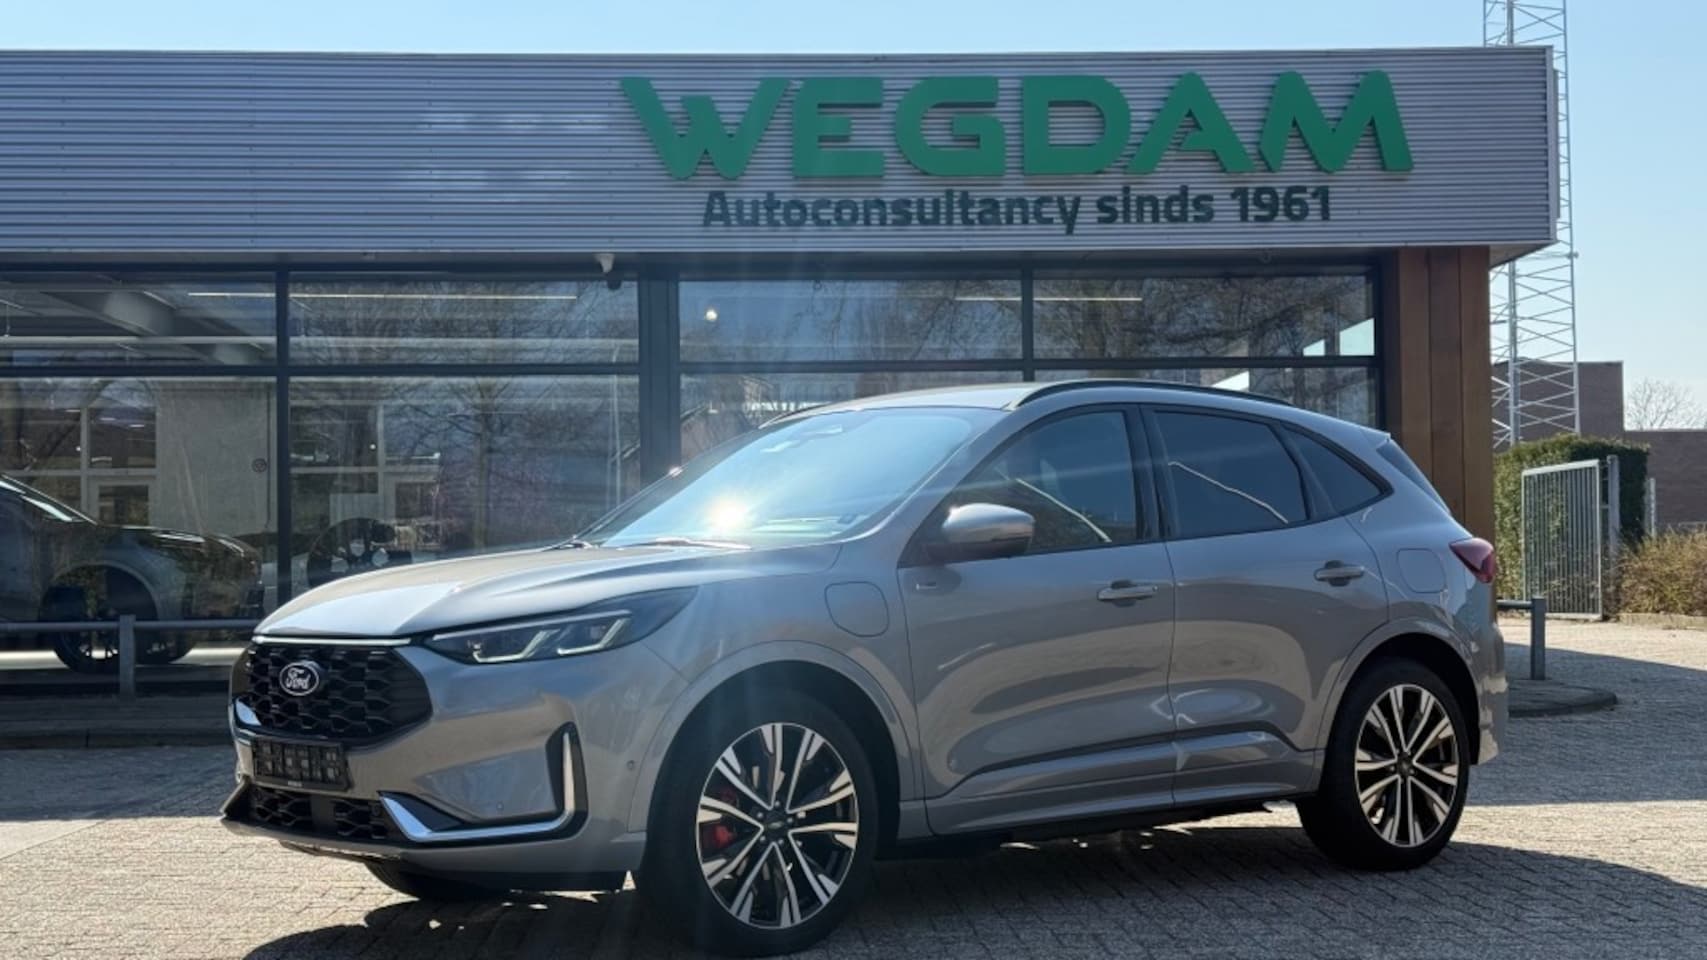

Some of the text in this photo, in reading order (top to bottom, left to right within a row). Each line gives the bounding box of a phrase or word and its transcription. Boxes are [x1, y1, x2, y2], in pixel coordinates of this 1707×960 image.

[620, 70, 1413, 180] WEGDAM
[704, 185, 1331, 235] Autoconsultancy sinds 1961
[286, 668, 312, 689] Ford
